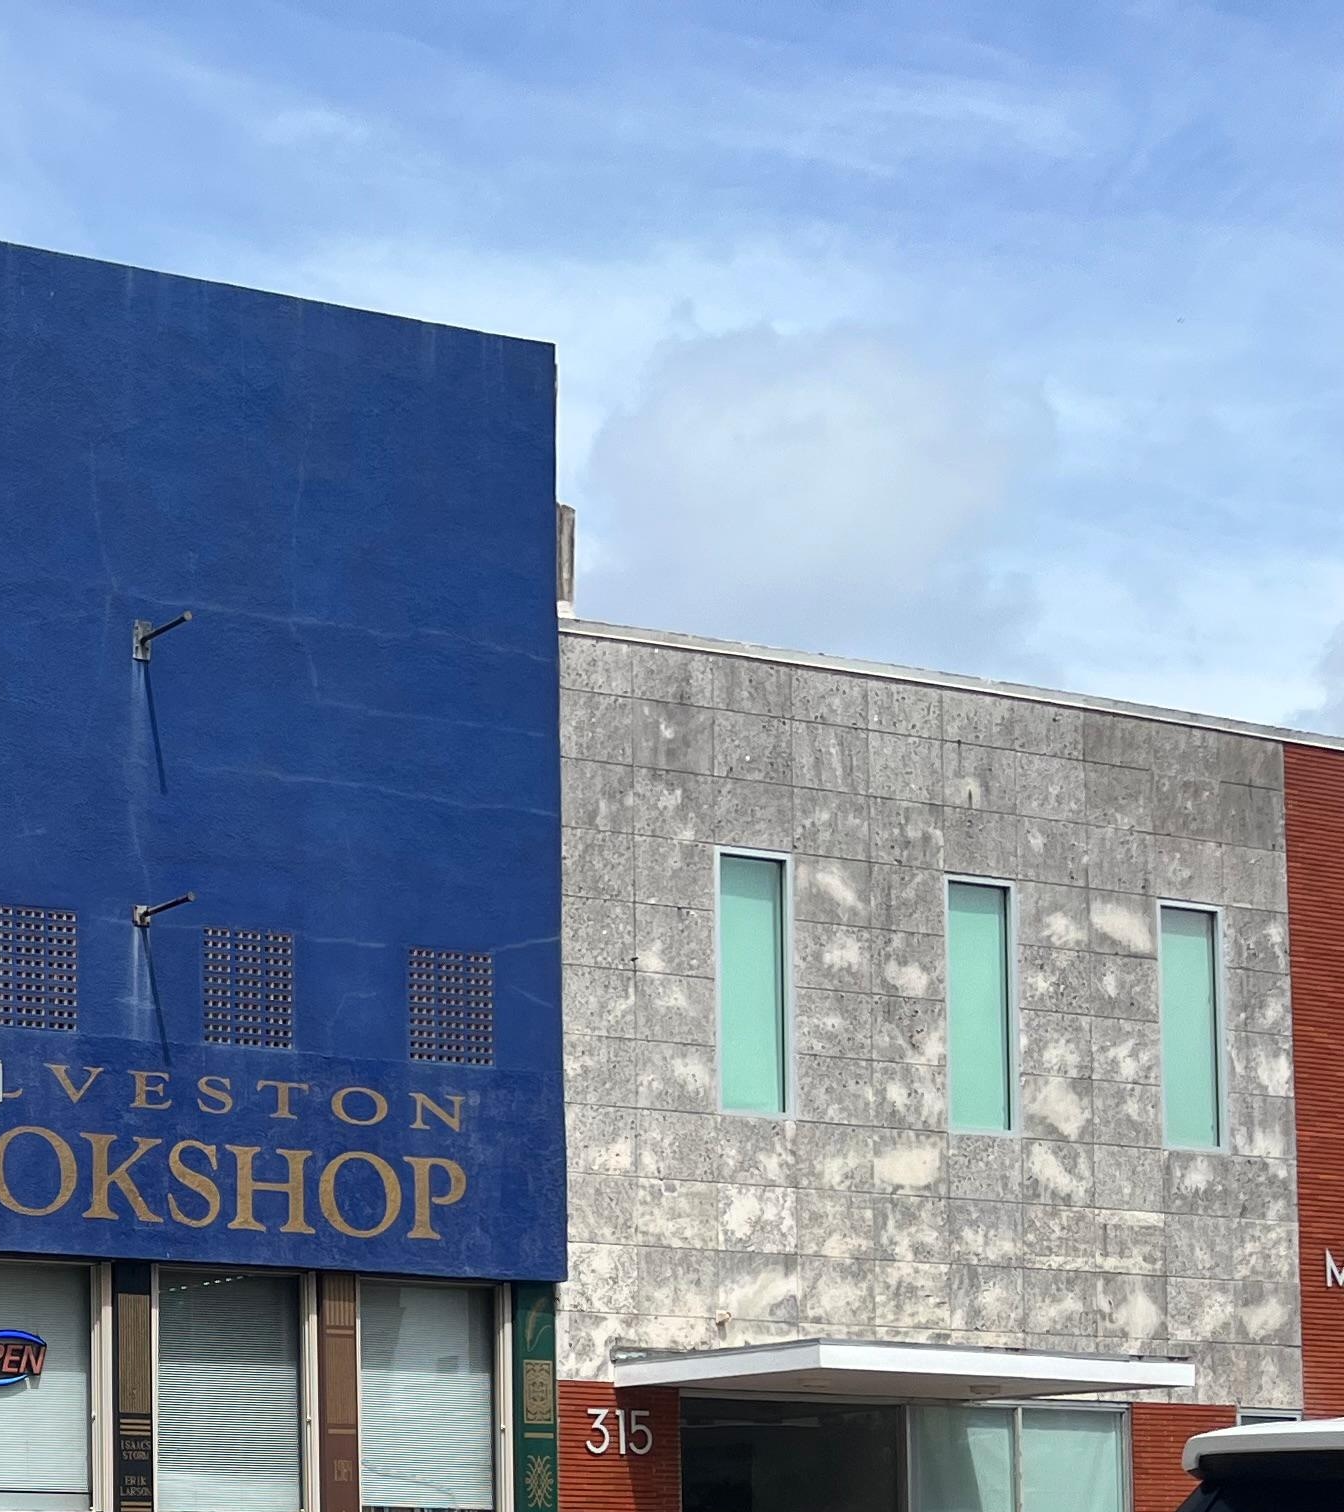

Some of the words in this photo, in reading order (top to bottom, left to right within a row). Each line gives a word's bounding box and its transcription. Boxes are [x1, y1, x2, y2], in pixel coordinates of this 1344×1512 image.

[2, 1063, 465, 1133] VESTON
[585, 1408, 653, 1456] 315
[120, 1486, 152, 1497] LARSON
[124, 1475, 147, 1486] ERIK
